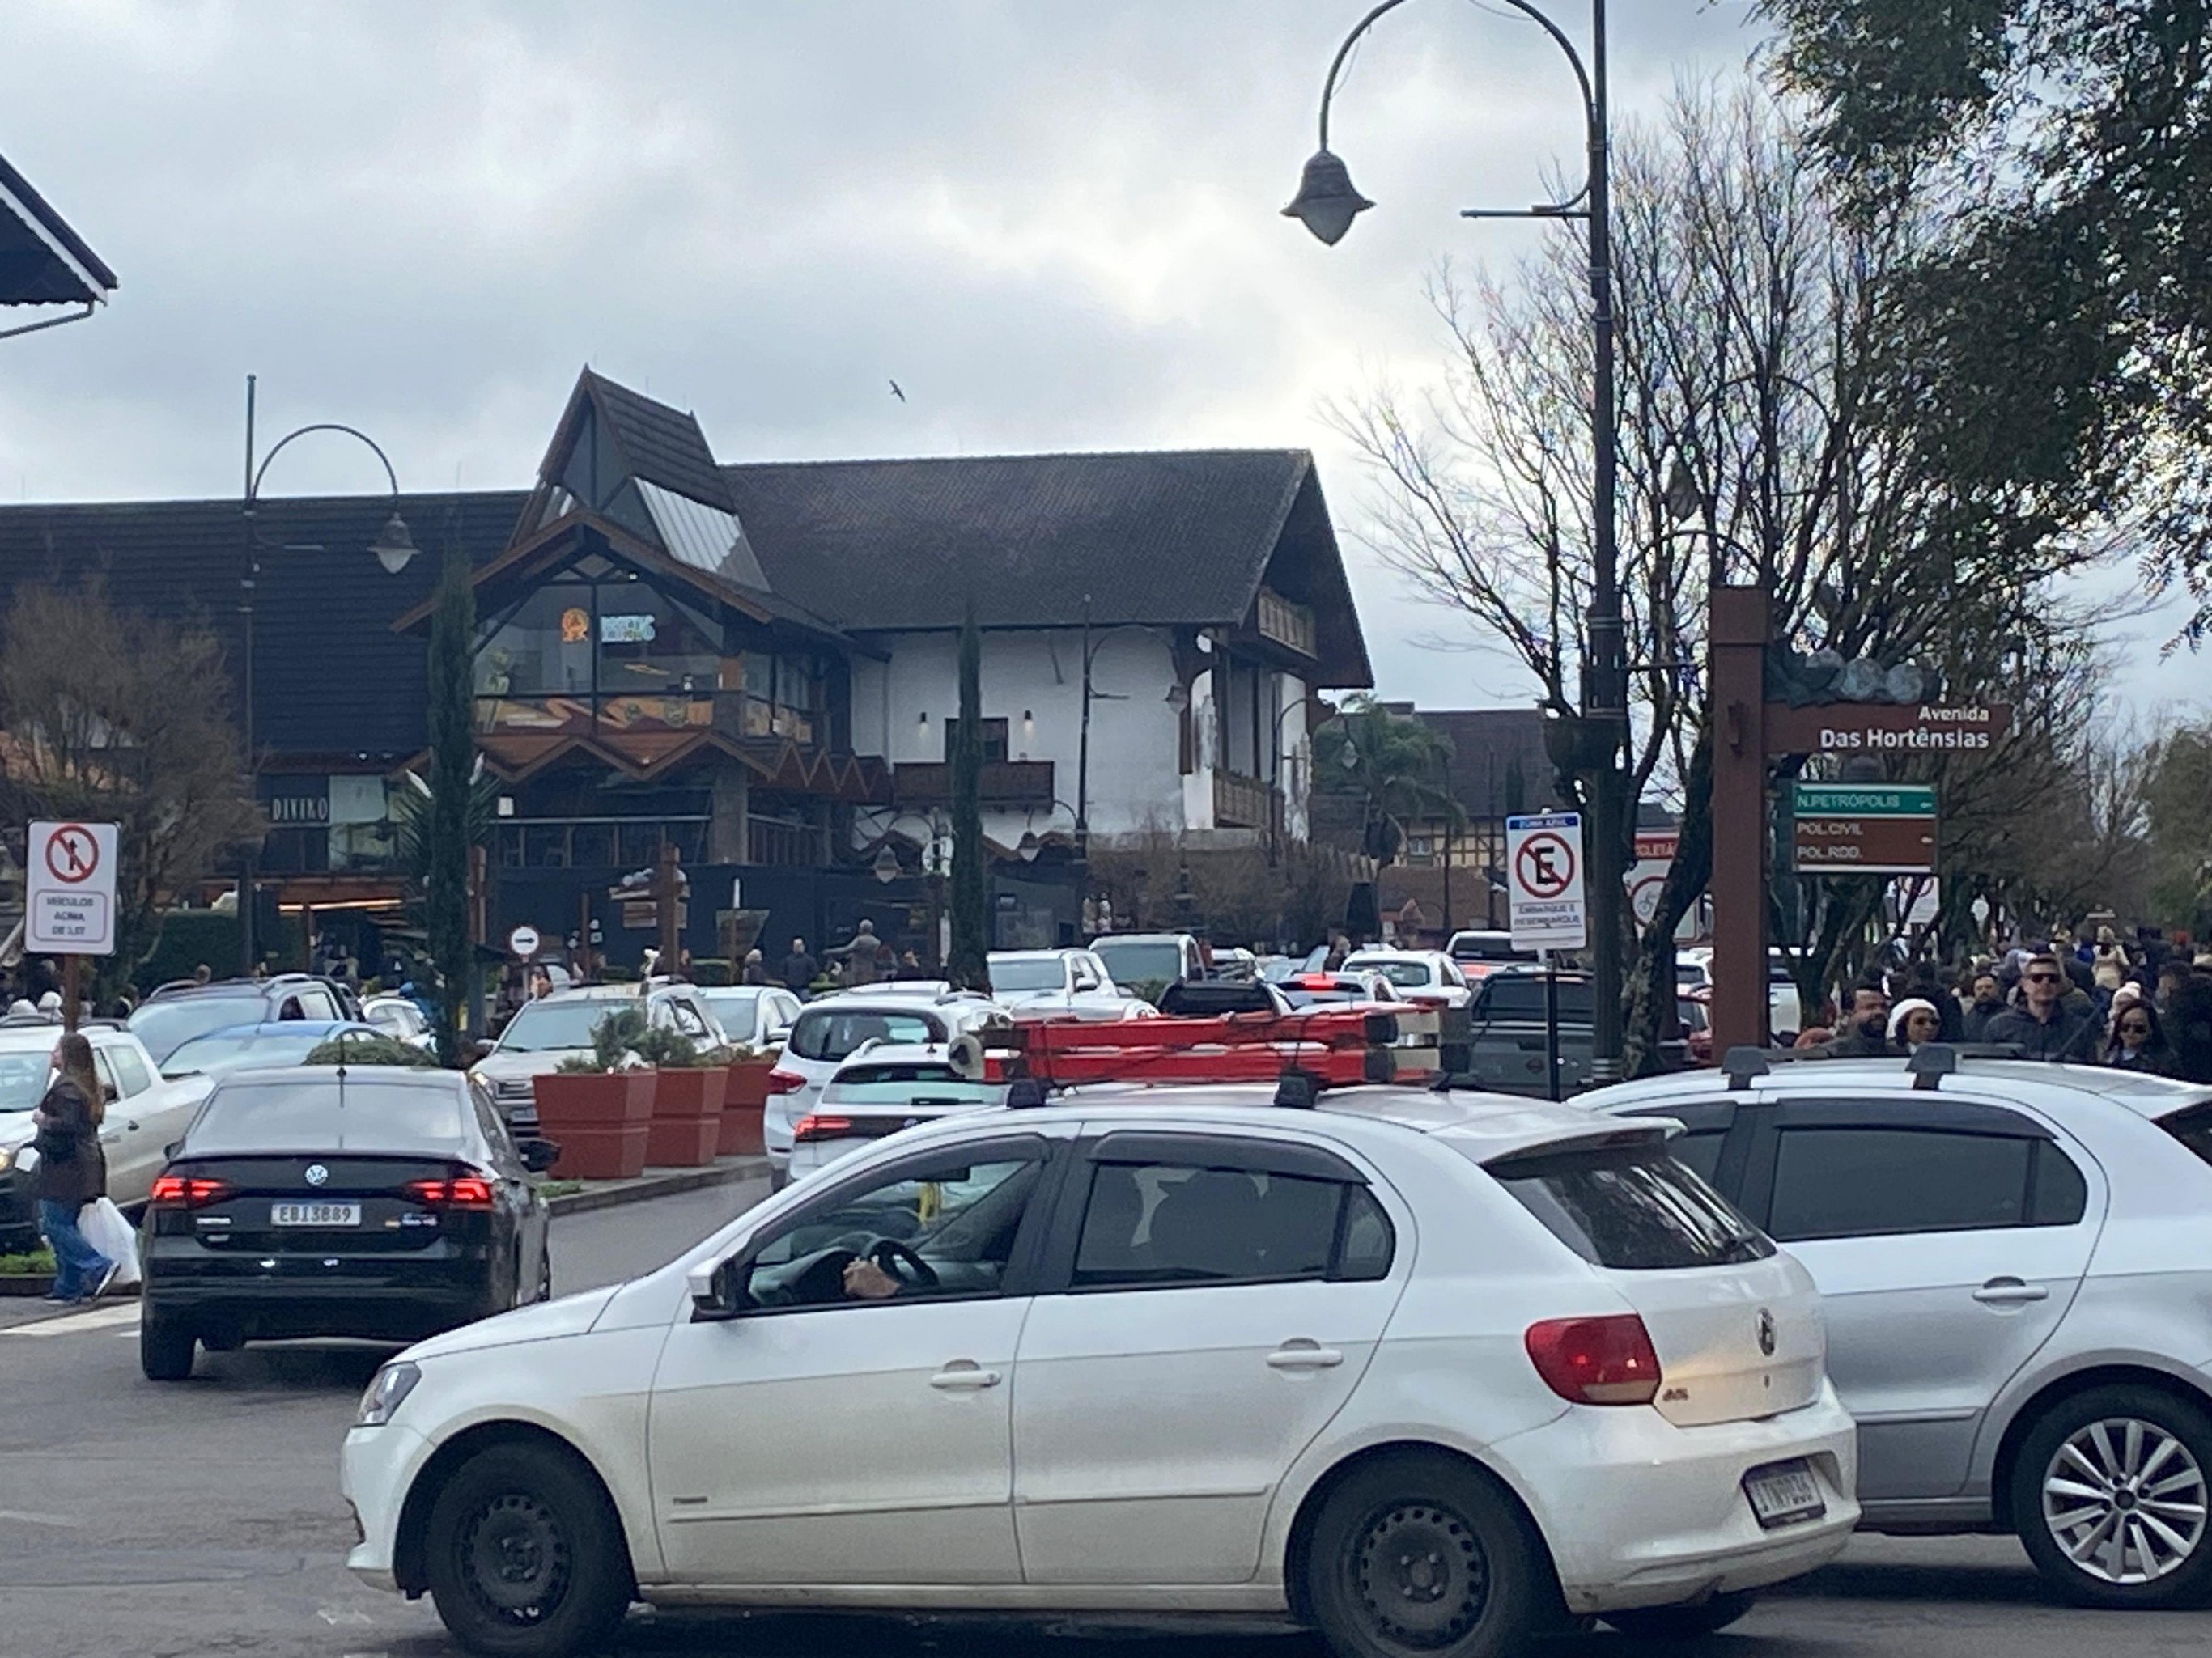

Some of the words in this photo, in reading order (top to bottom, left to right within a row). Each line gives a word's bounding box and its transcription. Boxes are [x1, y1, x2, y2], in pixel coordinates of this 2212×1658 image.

[1918, 706, 1989, 722] Avenida
[1821, 729, 1861, 748] Das
[1867, 727, 1989, 748] Hortênsias
